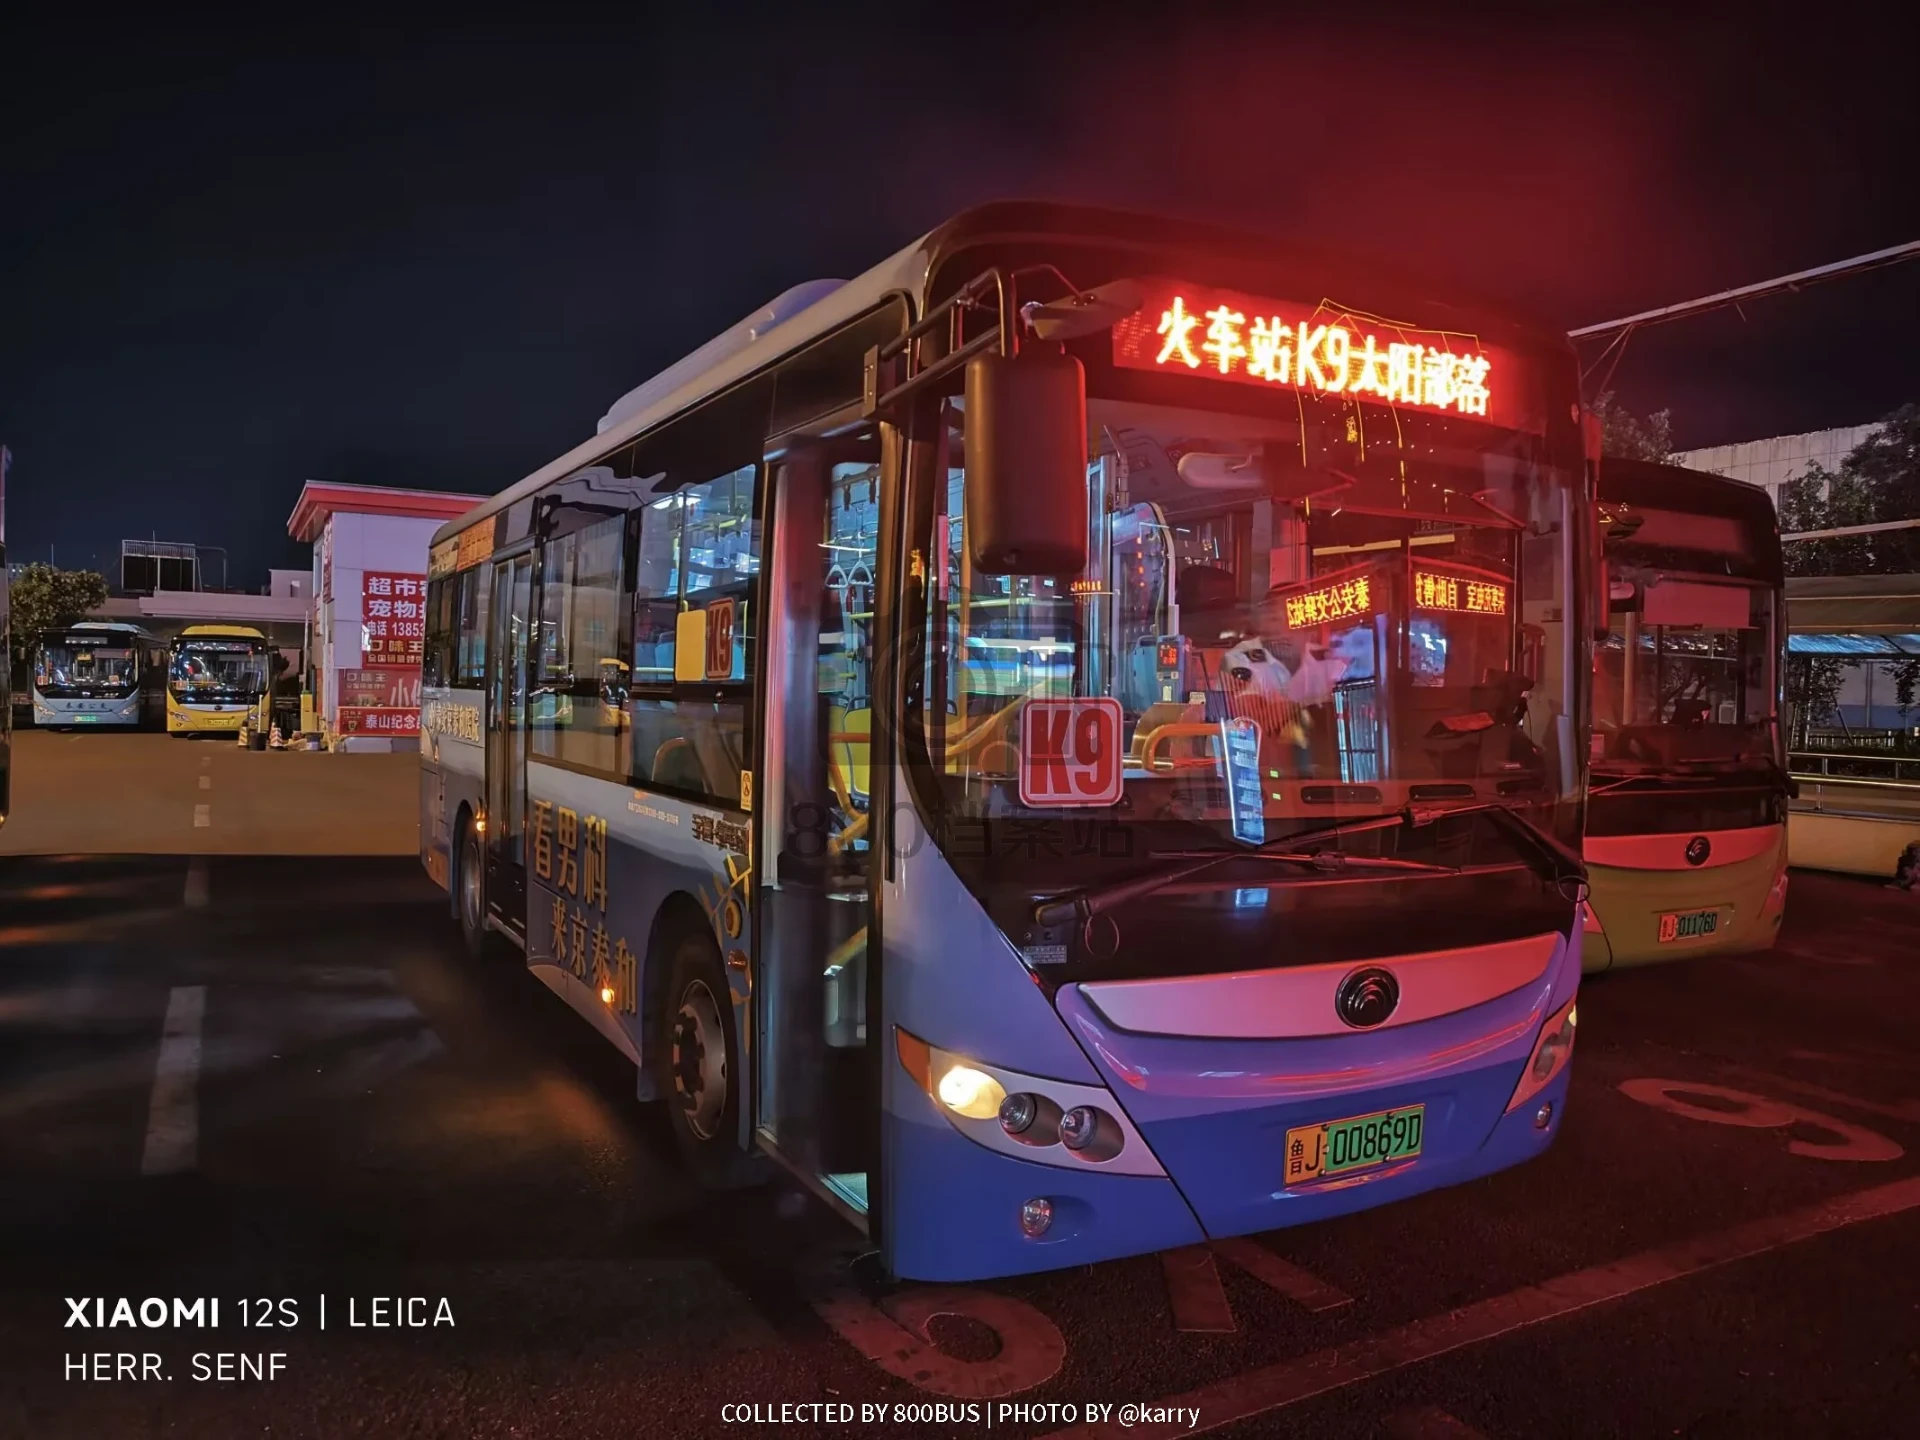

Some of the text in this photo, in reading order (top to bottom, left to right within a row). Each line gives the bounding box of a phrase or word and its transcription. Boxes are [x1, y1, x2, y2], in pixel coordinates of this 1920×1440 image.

[1156, 297, 1491, 416] 火车站K9太阳部落
[708, 607, 732, 672] K9
[1030, 709, 1113, 795] K9
[534, 800, 608, 913] 看男科
